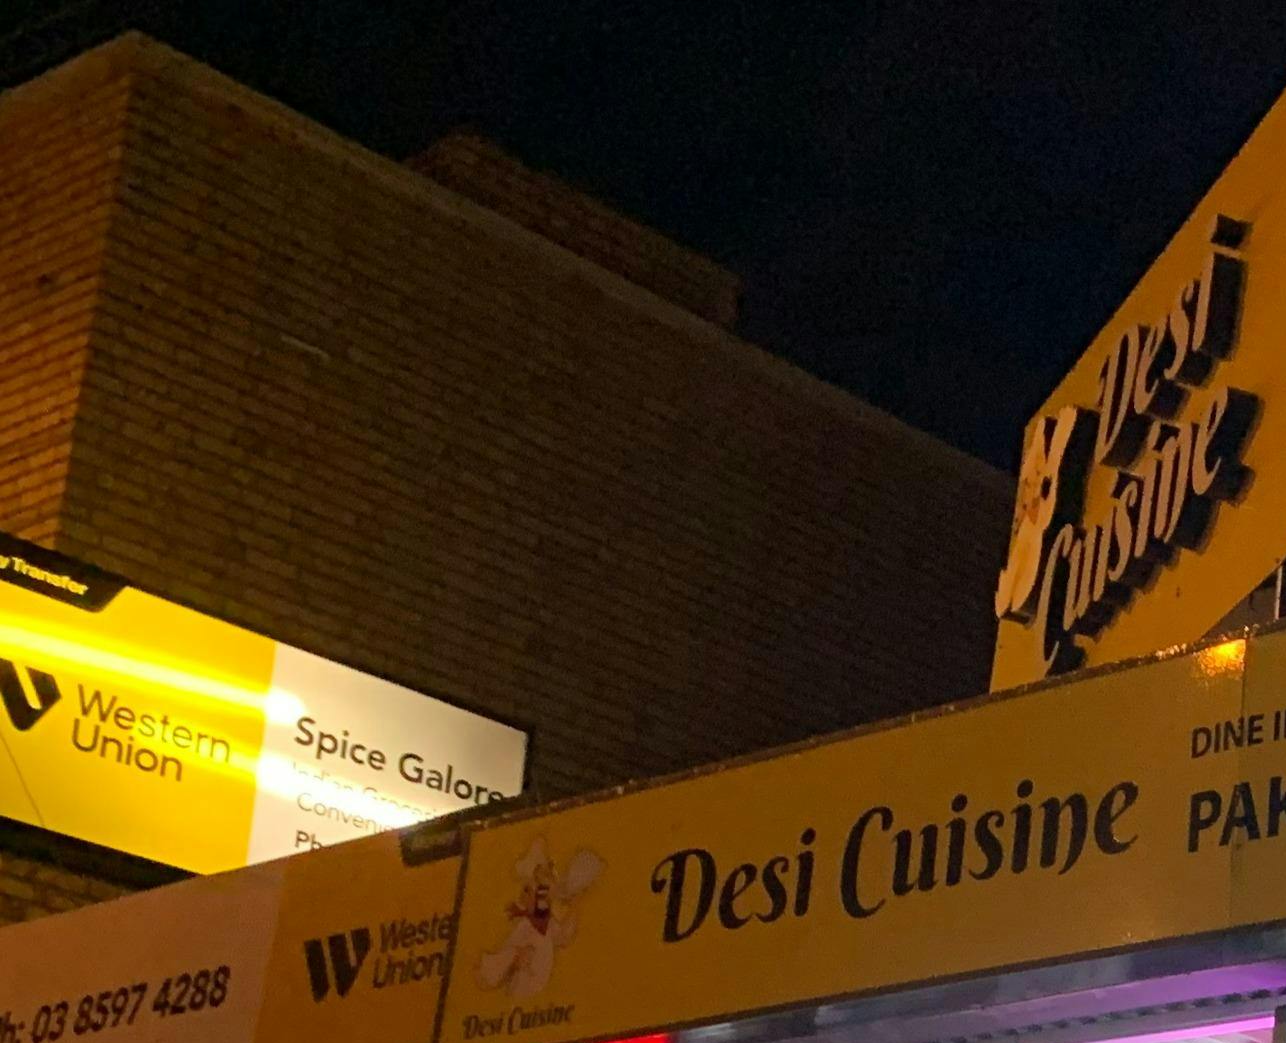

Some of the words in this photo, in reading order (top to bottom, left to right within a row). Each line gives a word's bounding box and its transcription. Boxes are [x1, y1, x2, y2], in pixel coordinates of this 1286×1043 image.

[1098, 213, 1232, 464] Desi
[1040, 385, 1228, 677] Cuisine
[12, 556, 89, 595] Transfer
[71, 717, 183, 782] Union
[77, 683, 232, 763] Western
[293, 716, 386, 771] Spice
[1190, 712, 1265, 759] DINE
[650, 827, 817, 944] Desi
[839, 778, 1141, 919] Cuisine
[379, 911, 453, 953] Weste
[73, 982, 148, 1035] 8597
[152, 965, 231, 1018] 4288
[372, 950, 449, 989] Union
